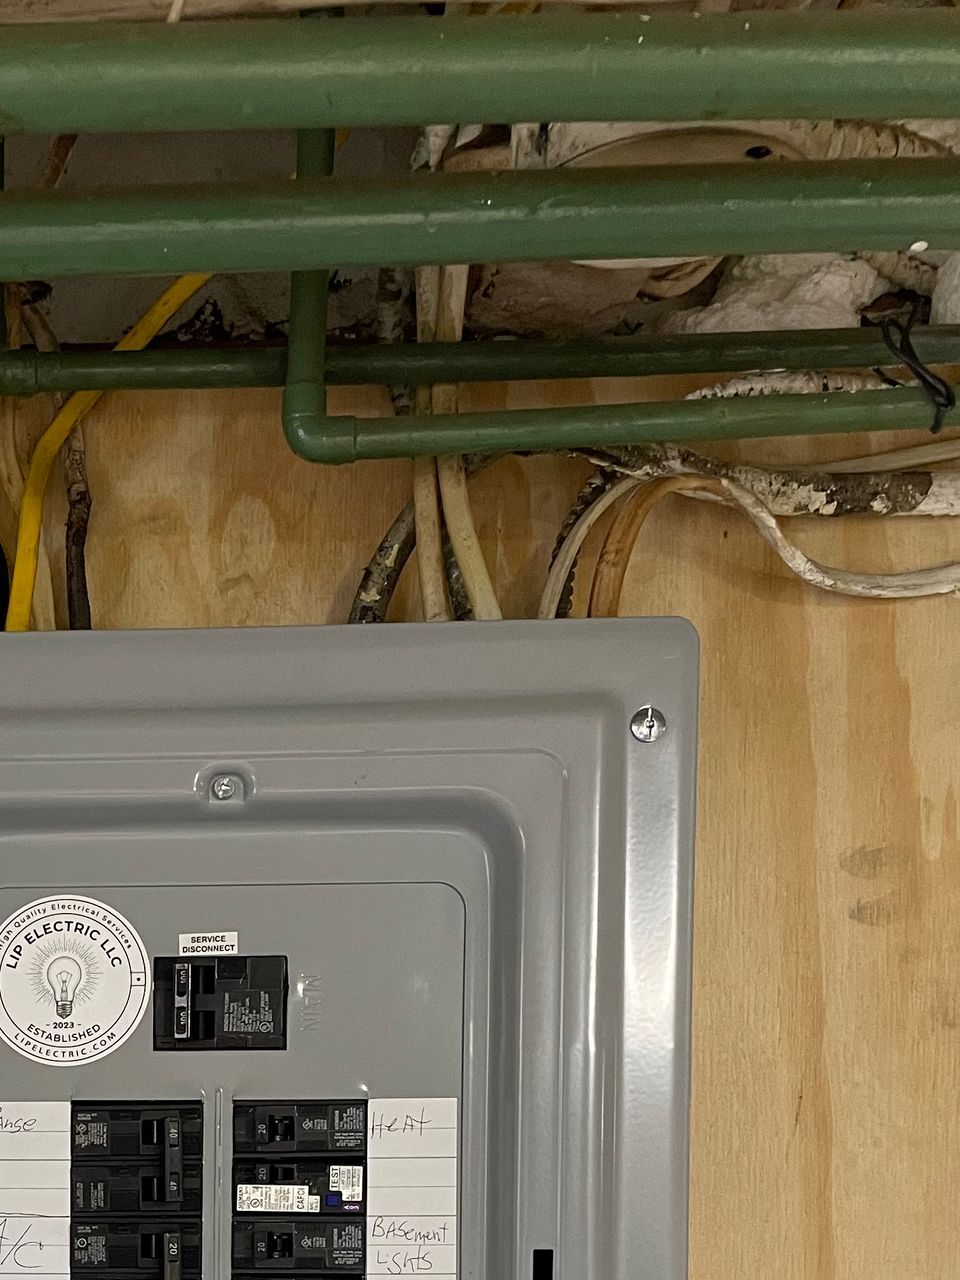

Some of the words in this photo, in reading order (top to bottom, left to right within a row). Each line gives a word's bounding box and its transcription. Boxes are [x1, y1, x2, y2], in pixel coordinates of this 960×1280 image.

[14, 907, 47, 927] Quality
[51, 903, 100, 917] Electrical
[102, 915, 132, 949] Services
[6, 946, 24, 969] LIP
[24, 921, 101, 945] ELECTRIC
[101, 939, 122, 968] LLC
[182, 945, 235, 953] DISCONNECT
[27, 1024, 101, 1042] ESTABLISHED
[15, 1032, 117, 1058] LIPELECTRIC.COM
[169, 1128, 178, 1138] 40
[258, 1124, 266, 1134] 20
[296, 1187, 305, 1210] CAFCI
[169, 1243, 178, 1255] 20
[257, 1242, 265, 1252] 20
